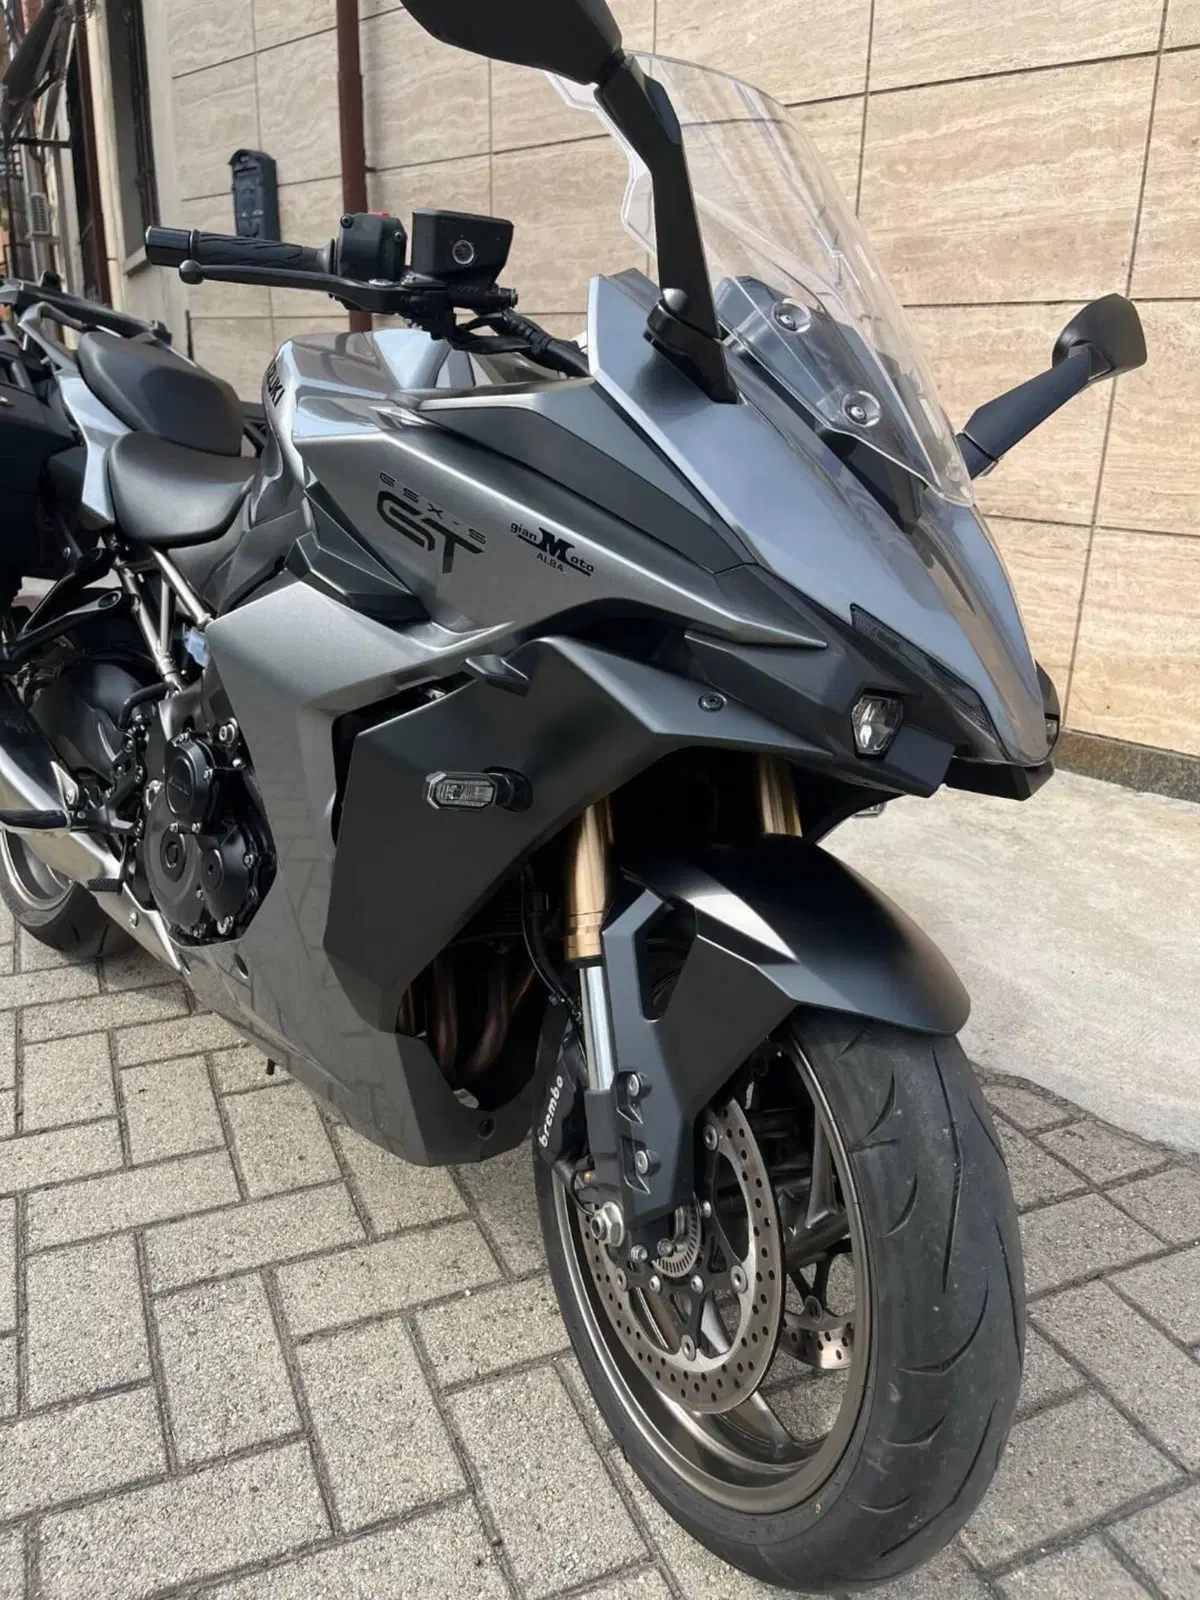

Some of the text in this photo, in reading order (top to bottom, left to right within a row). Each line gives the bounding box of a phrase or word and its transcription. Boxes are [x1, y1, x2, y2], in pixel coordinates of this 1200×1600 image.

[377, 491, 484, 574] GT
[380, 471, 486, 545] GSX-S
[536, 552, 564, 573] ALBA
[538, 1075, 563, 1148] brembo
